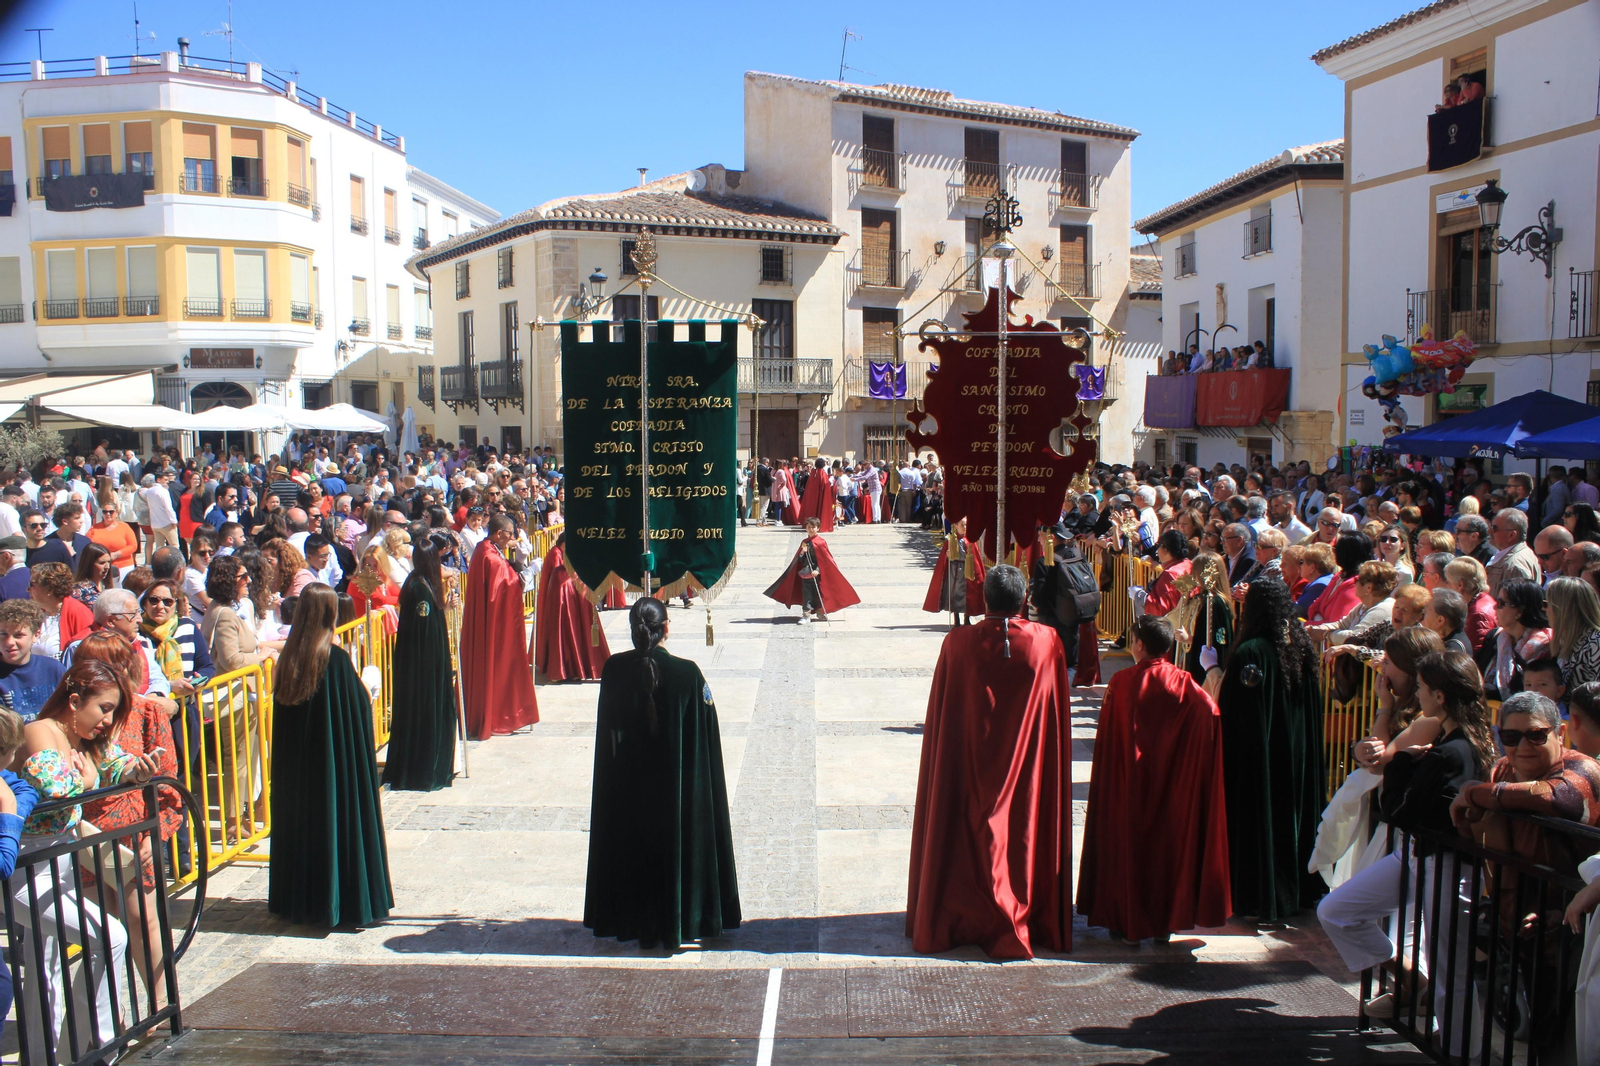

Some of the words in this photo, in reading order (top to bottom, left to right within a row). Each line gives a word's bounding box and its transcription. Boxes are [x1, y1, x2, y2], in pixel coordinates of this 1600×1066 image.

[666, 375, 699, 388] SRA.
[566, 398, 589, 410] DE
[602, 398, 625, 409] LA
[1457, 396, 1487, 409] Unicaja
[977, 403, 1029, 417] CRSTO
[988, 423, 1017, 435] DL
[593, 441, 636, 454] STMO.
[652, 440, 704, 455] CRISTO
[580, 464, 612, 477] DEL
[703, 462, 715, 476] Y
[1009, 465, 1054, 478] RUBIO
[573, 486, 594, 498] DE
[606, 486, 632, 498] LOS
[648, 485, 728, 500] AFLIGIDOS
[961, 482, 983, 492] AÑO
[576, 527, 626, 540] VELEZ
[696, 527, 724, 540] 2017
